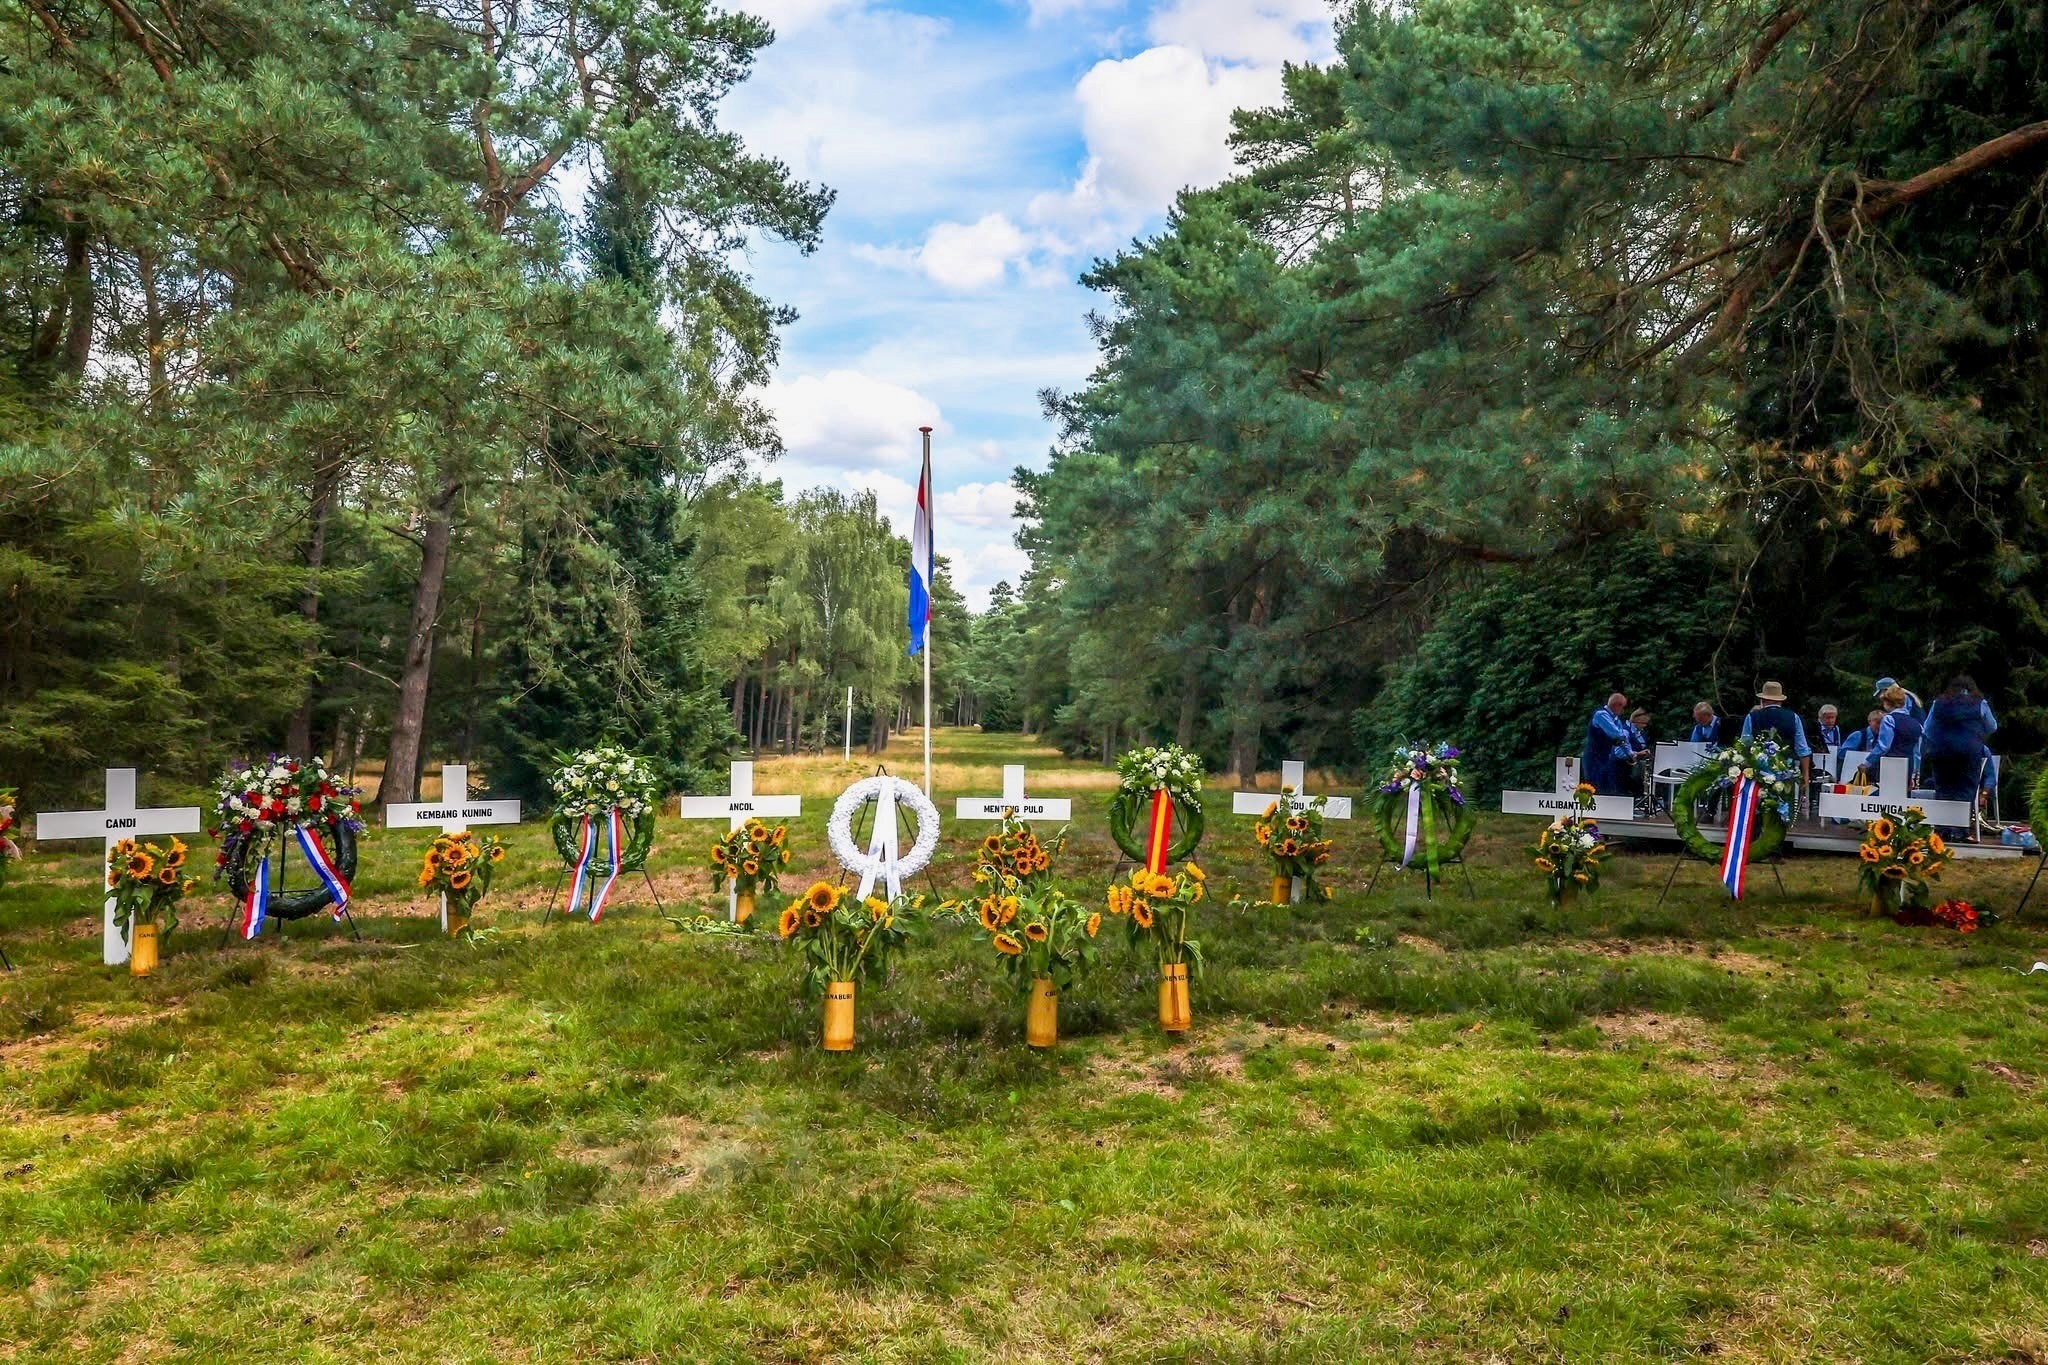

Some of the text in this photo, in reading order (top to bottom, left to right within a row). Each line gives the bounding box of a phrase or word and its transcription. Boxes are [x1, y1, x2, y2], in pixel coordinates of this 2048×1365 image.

[729, 802, 755, 811] ANCOL
[1023, 805, 1044, 814] PULO
[416, 808, 493, 820] KEMBANG KUNING
[105, 818, 136, 829] CANDI
